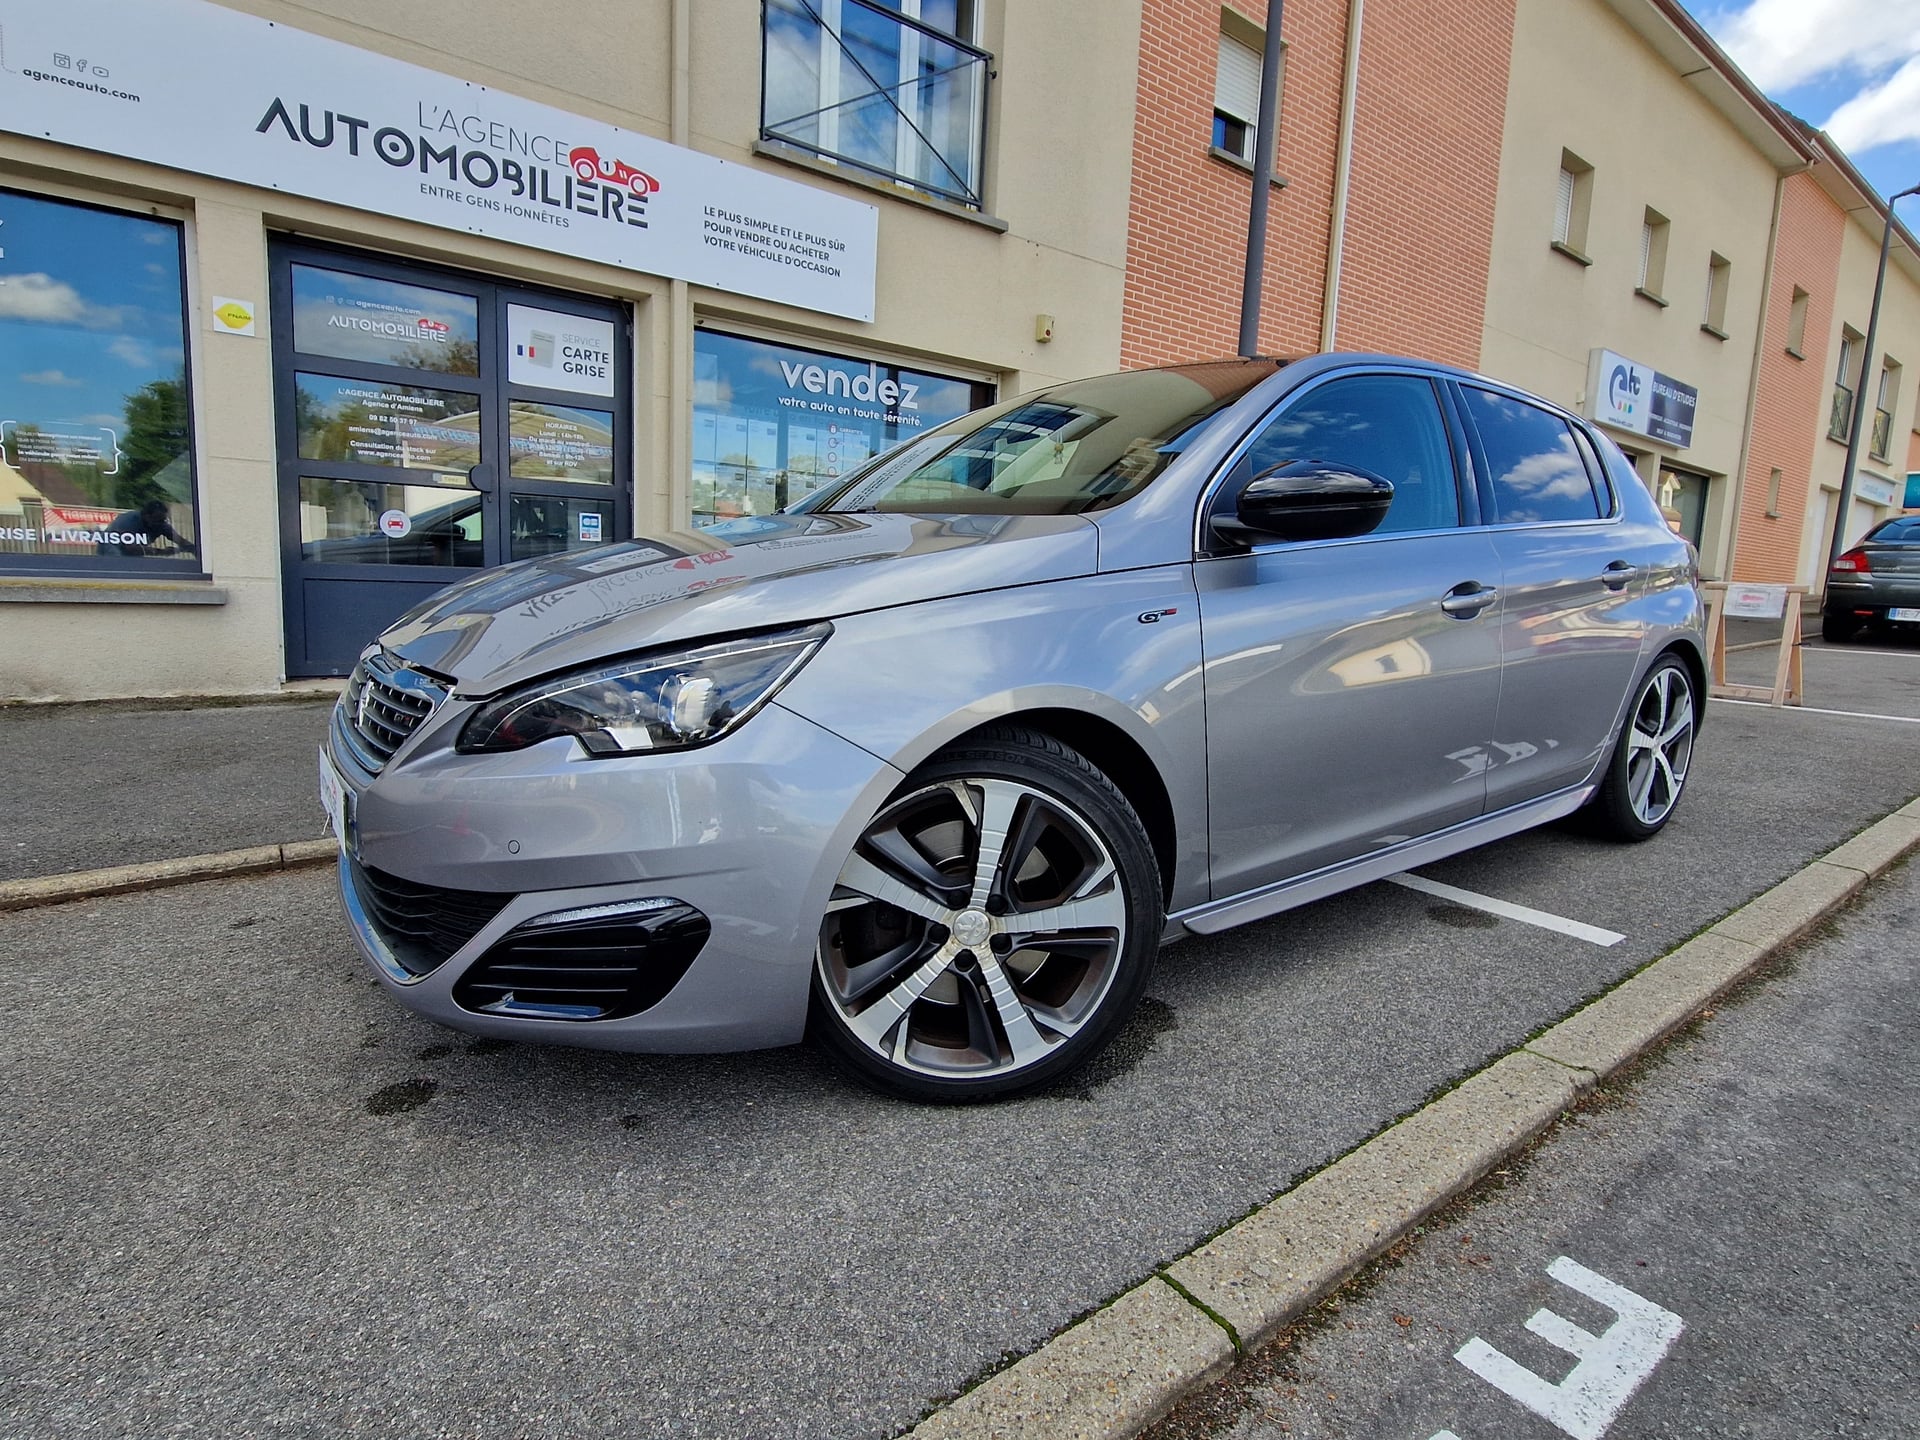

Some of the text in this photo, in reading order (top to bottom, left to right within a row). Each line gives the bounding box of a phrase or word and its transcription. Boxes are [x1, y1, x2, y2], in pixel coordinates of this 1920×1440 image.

[22, 66, 140, 102] agenceauto.com
[418, 100, 569, 168] L'AGENCE
[420, 183, 570, 228] ENTRE GENS HONNÊTES
[704, 205, 846, 252] LE PLUS SIMPLE ET LE PLUS SÛR
[704, 220, 830, 261] POUR VENDRE OU ACHETER
[704, 234, 840, 278] VOTRE VÉHICULE D'OCCASION
[356, 300, 421, 316] agenceauto.com
[562, 334, 600, 348] SERVICE
[562, 346, 609, 364] CARTE
[562, 362, 606, 378] GRISE
[338, 388, 379, 399] L'AGENCE
[780, 360, 919, 410] vendez
[1652, 382, 1672, 399] BUREAU
[362, 400, 389, 409] Agence
[778, 395, 922, 427] votre auto en toute sérénité.
[358, 450, 431, 461] www.agenceato.com
[50, 530, 148, 545] LIVRAISON
